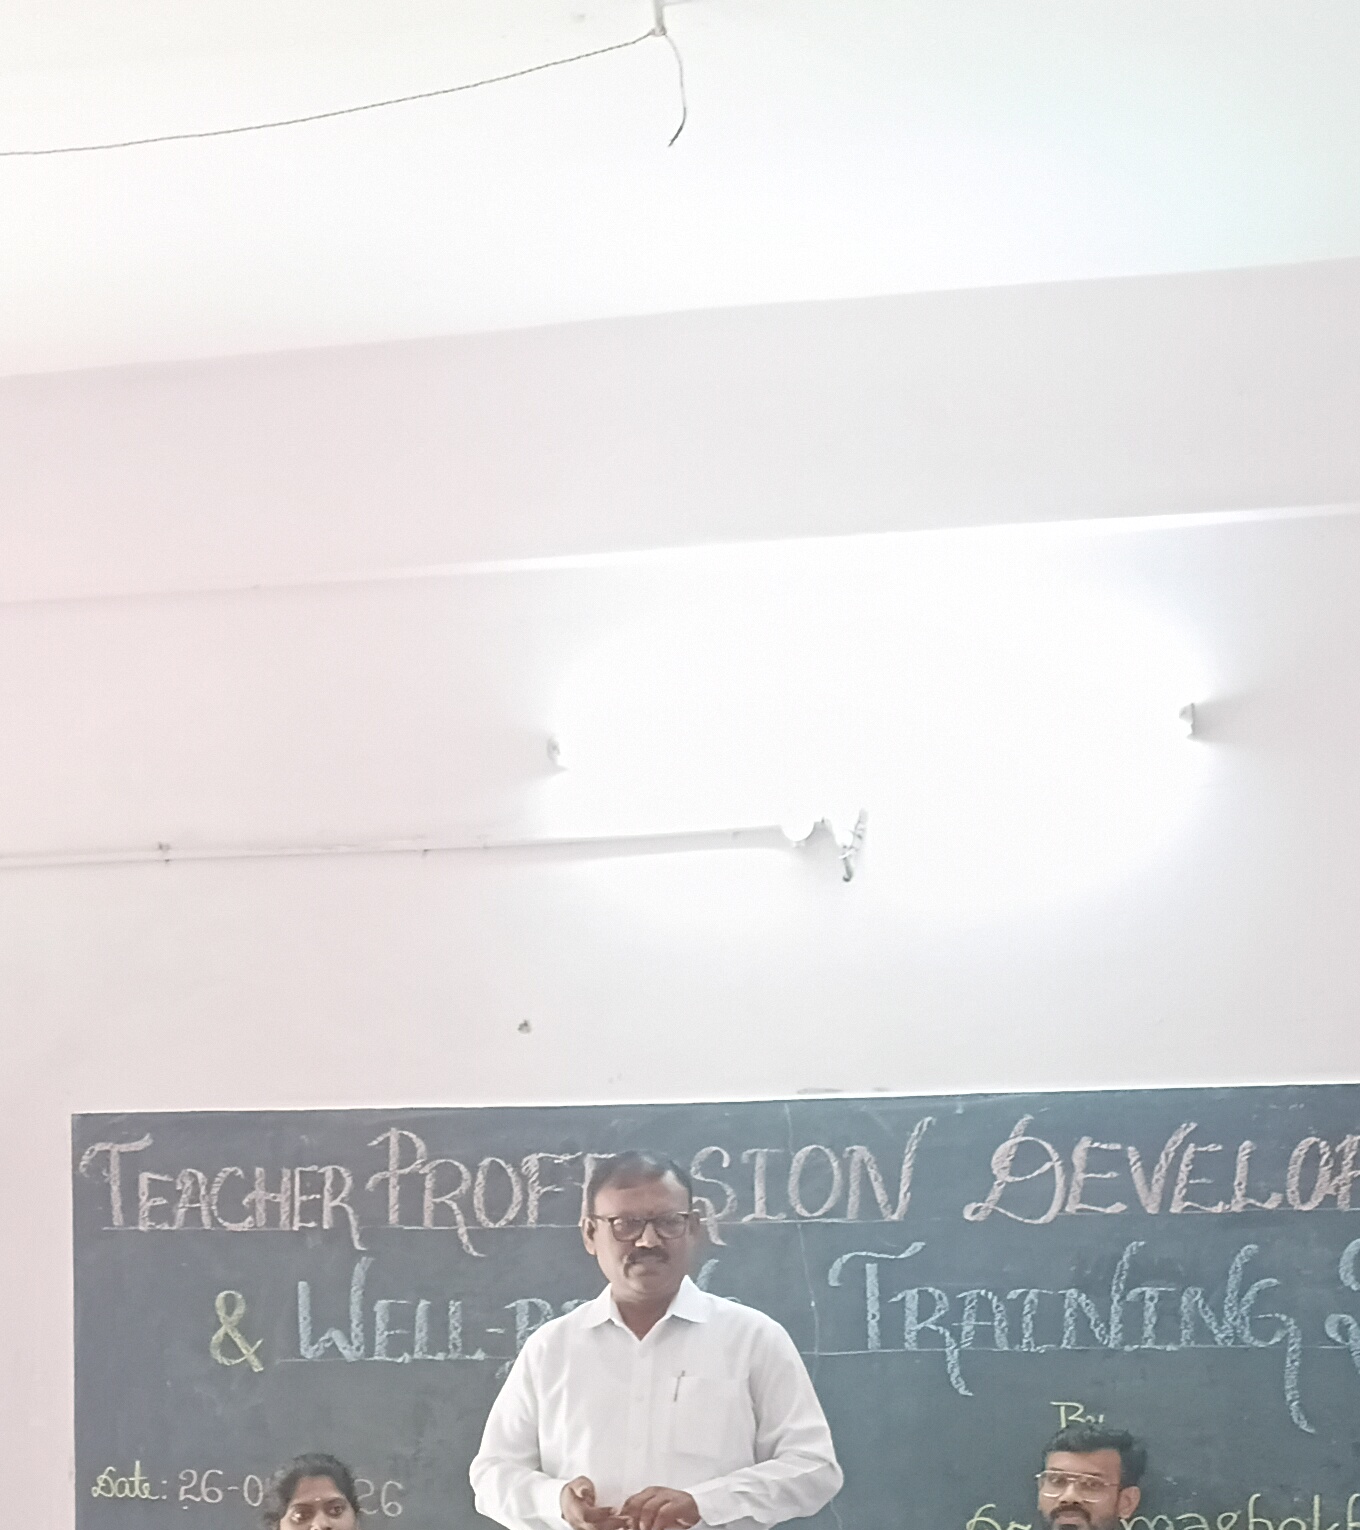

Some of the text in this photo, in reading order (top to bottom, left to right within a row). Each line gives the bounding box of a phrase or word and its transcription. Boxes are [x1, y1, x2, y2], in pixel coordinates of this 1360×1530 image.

[367, 1115, 936, 1257] PROFSION
[210, 1289, 264, 1372] &
[829, 1240, 1315, 1433] TRAINING
